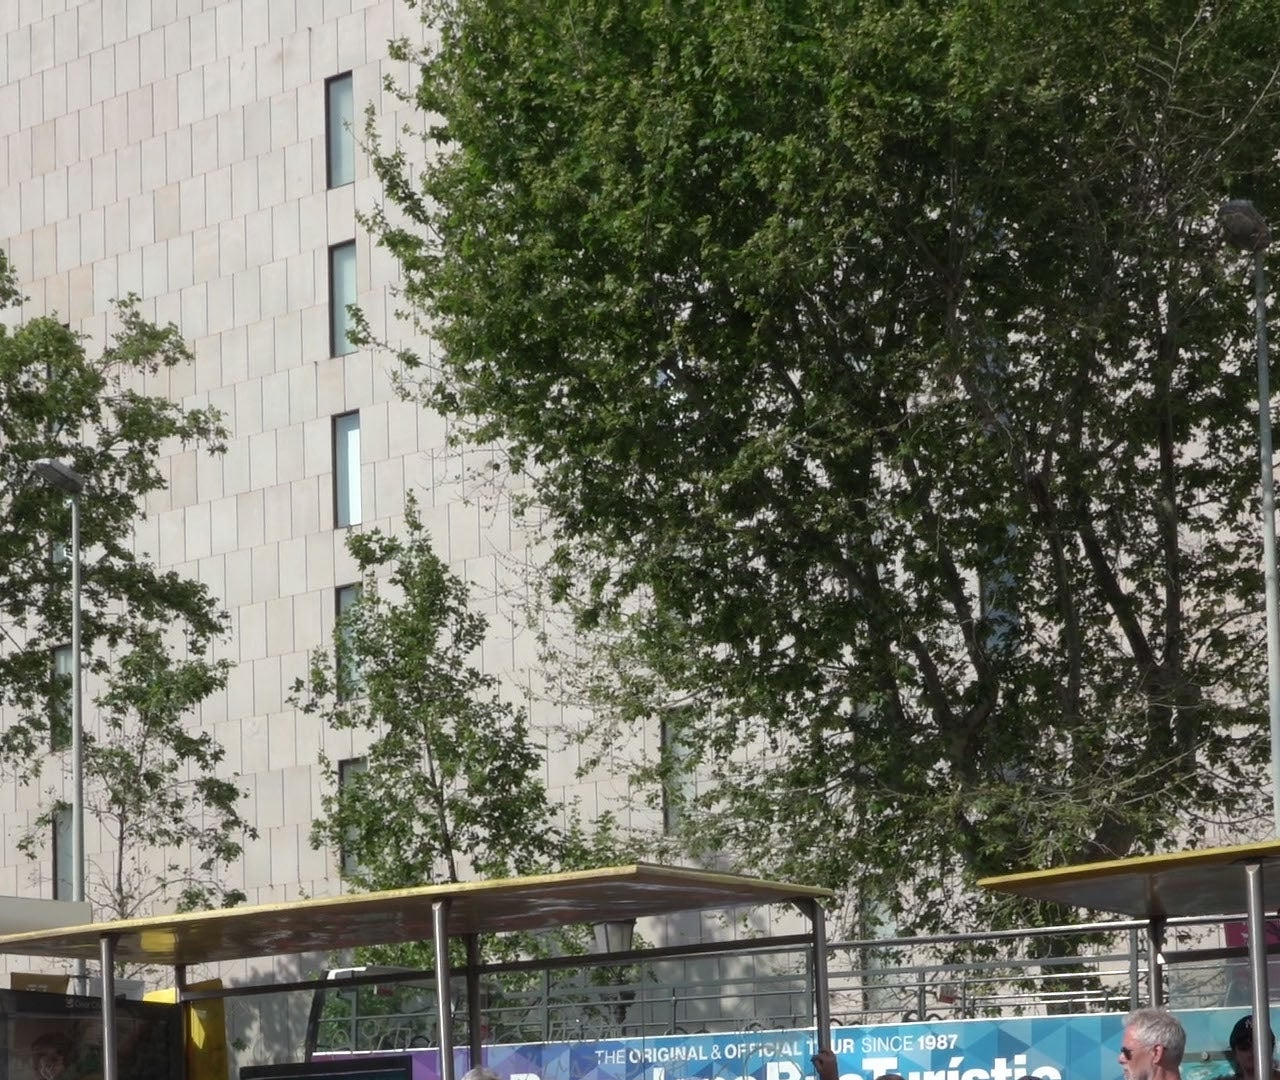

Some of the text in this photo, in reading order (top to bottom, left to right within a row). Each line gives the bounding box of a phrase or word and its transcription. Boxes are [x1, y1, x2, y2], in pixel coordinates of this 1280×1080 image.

[595, 1034, 959, 1065] THE ORIGINAL & OFFICIAL TUR SINCE 1987
